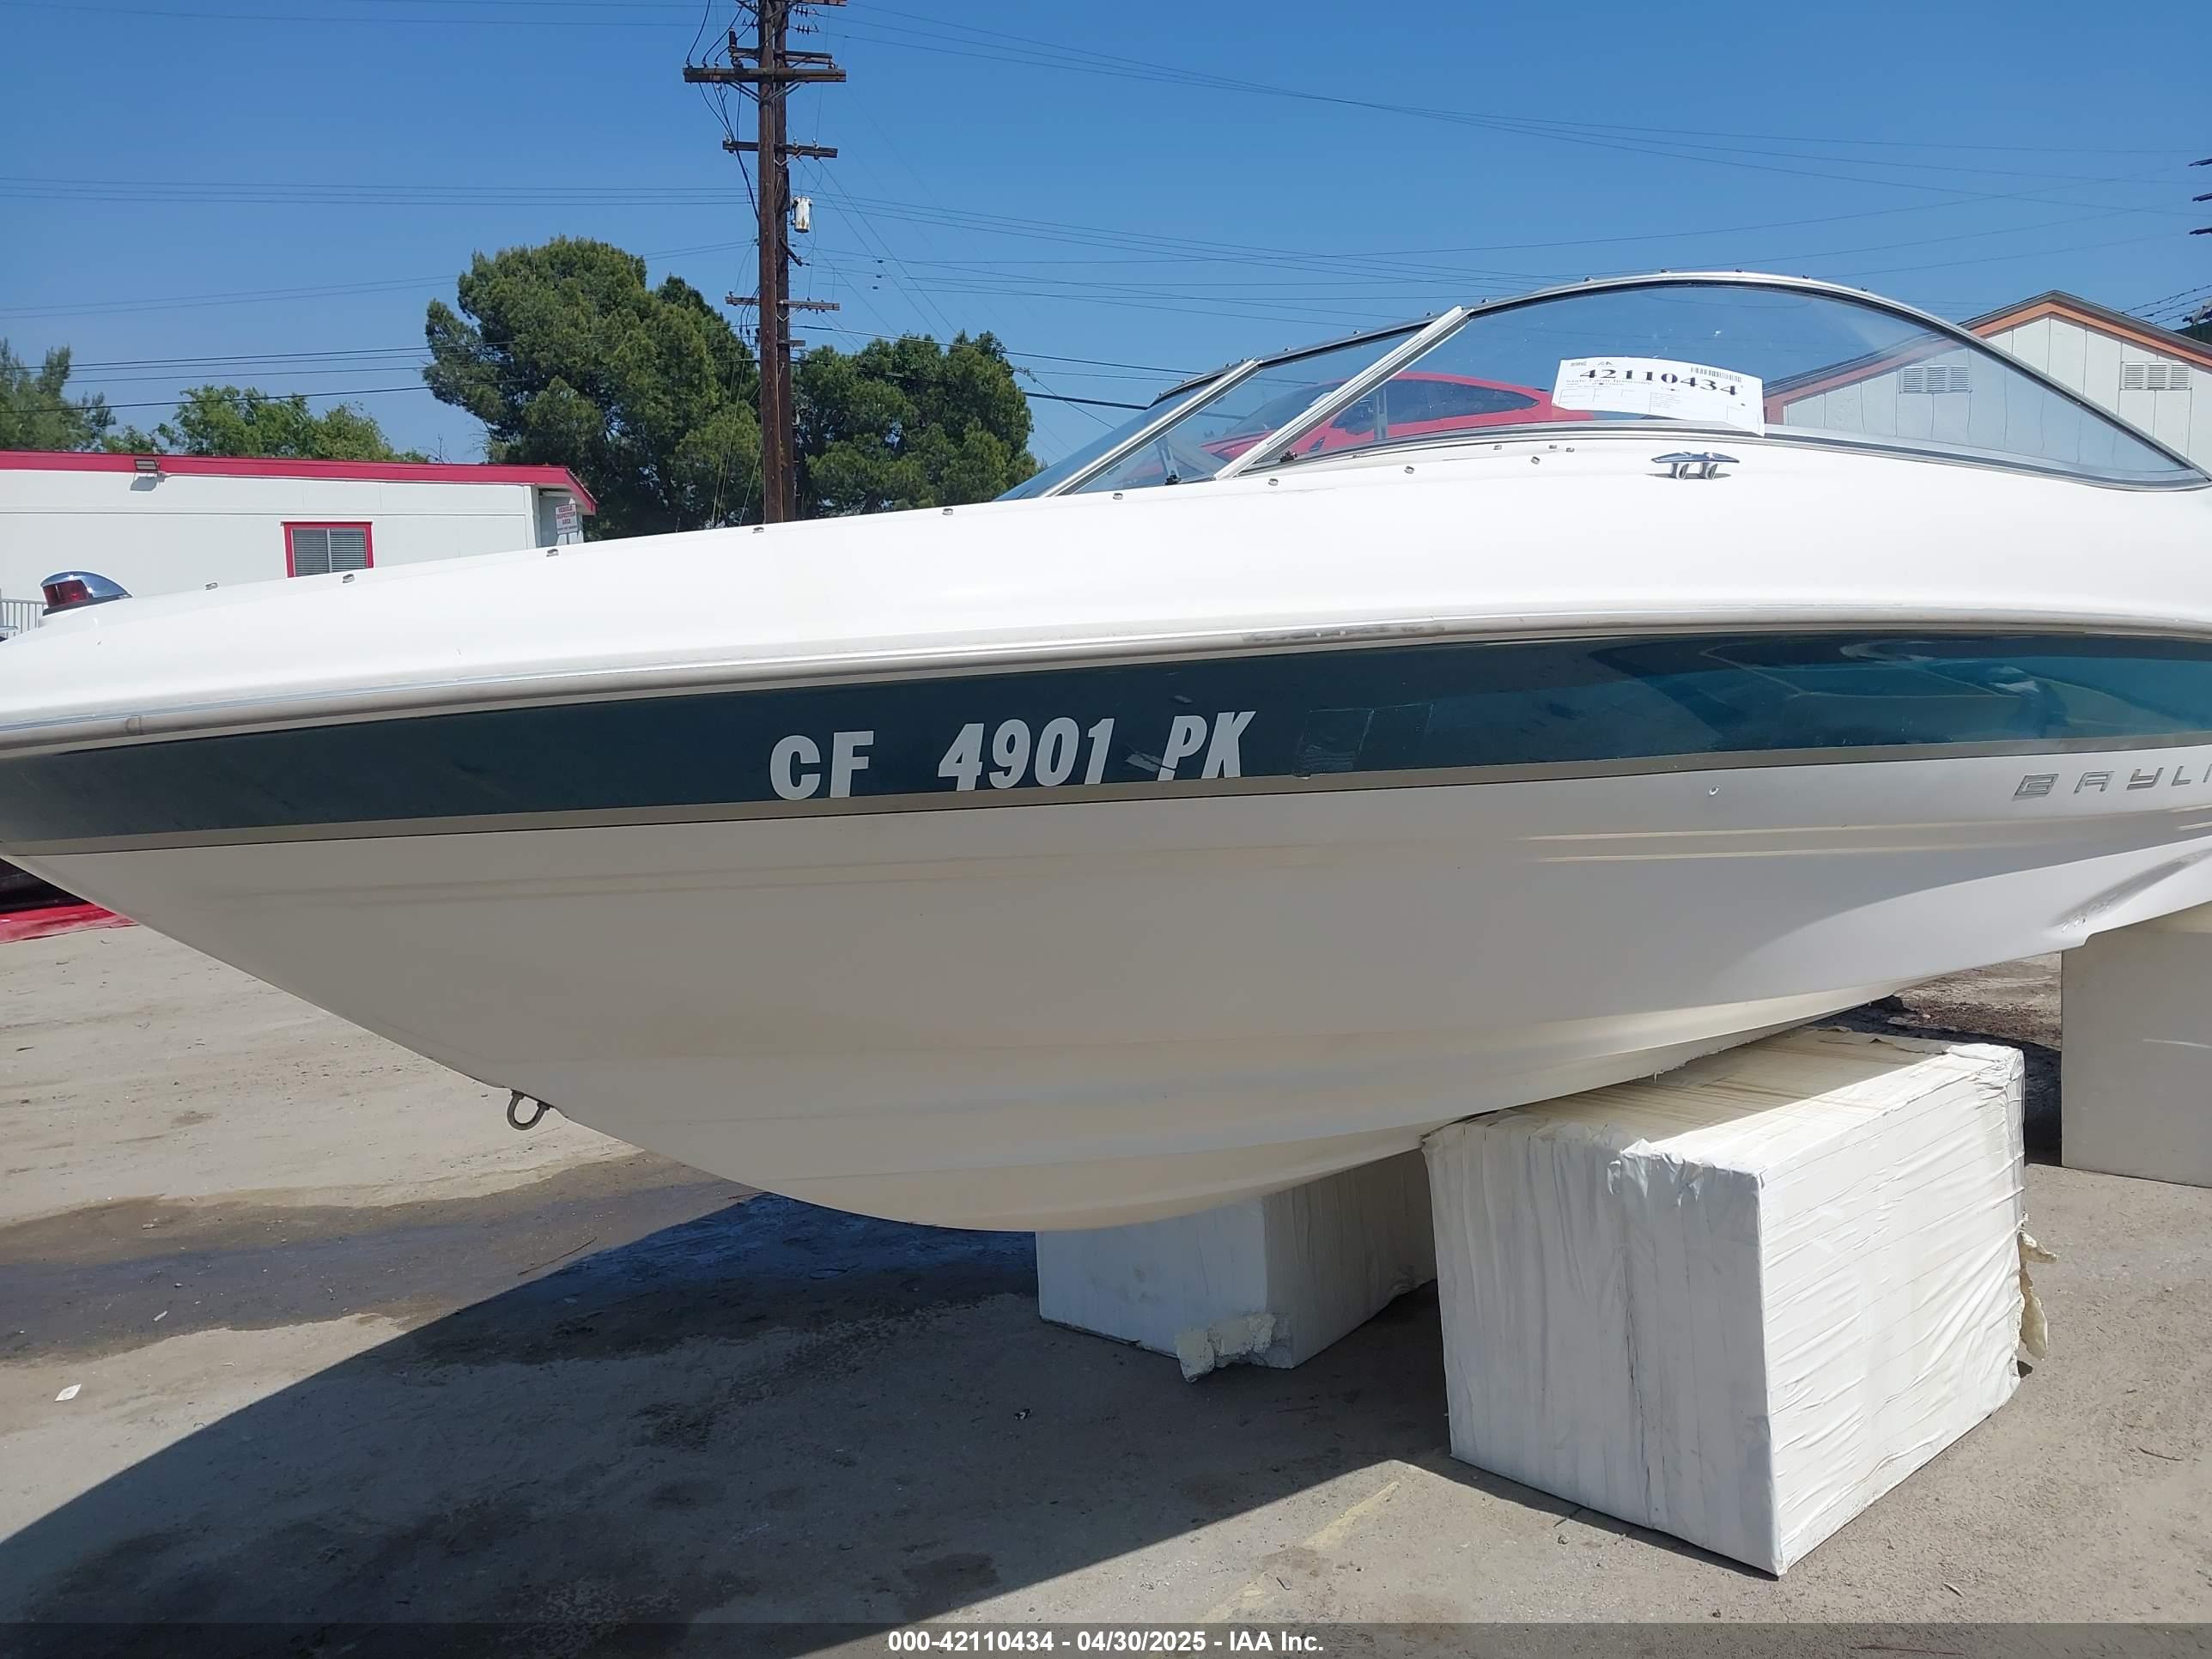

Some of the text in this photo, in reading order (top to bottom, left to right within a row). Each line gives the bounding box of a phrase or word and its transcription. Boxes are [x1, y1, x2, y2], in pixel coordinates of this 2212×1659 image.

[1579, 368, 1738, 396] 42110434
[769, 711, 1257, 800] CF 4901 PK
